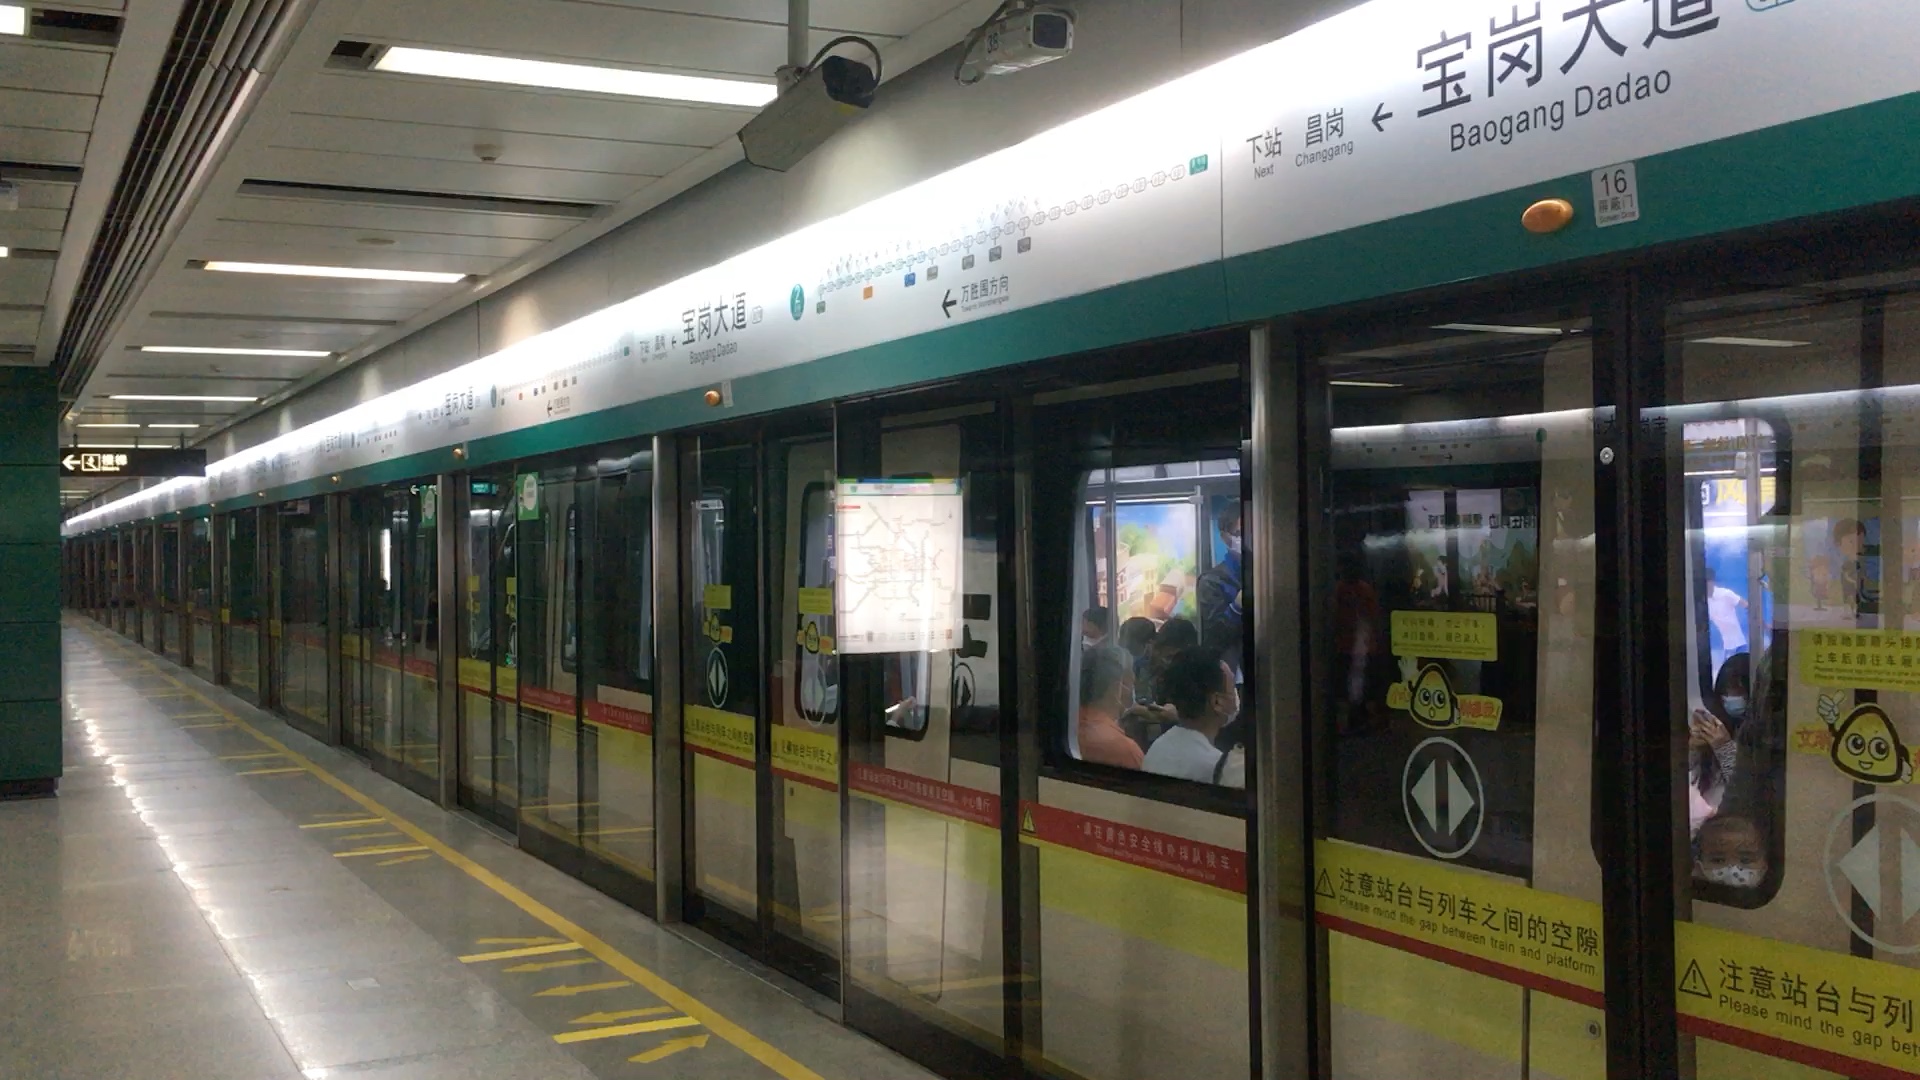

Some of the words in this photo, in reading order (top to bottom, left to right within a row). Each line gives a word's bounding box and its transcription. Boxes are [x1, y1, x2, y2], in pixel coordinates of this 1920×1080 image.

[1246, 127, 1283, 165] 下站
[1305, 107, 1344, 149] 昌岗
[1450, 99, 1564, 152] Baogang
[1574, 69, 1672, 117] Dadao
[1254, 163, 1275, 179] Next
[1295, 140, 1354, 167] Changgang
[1600, 168, 1628, 197] 16
[682, 291, 747, 346] 宝岗大道
[1339, 867, 1600, 957] 注意站台与列车之间的空隙
[1420, 918, 1438, 935] gap
[1442, 922, 1486, 946] between
[1490, 936, 1516, 953] train
[1520, 945, 1541, 961] and
[1719, 958, 1914, 1034] 注意站台与列
[1719, 994, 1769, 1020] Please
[1776, 1009, 1813, 1031] mind
[1820, 1020, 1845, 1039] the
[1853, 1029, 1883, 1051] gap
